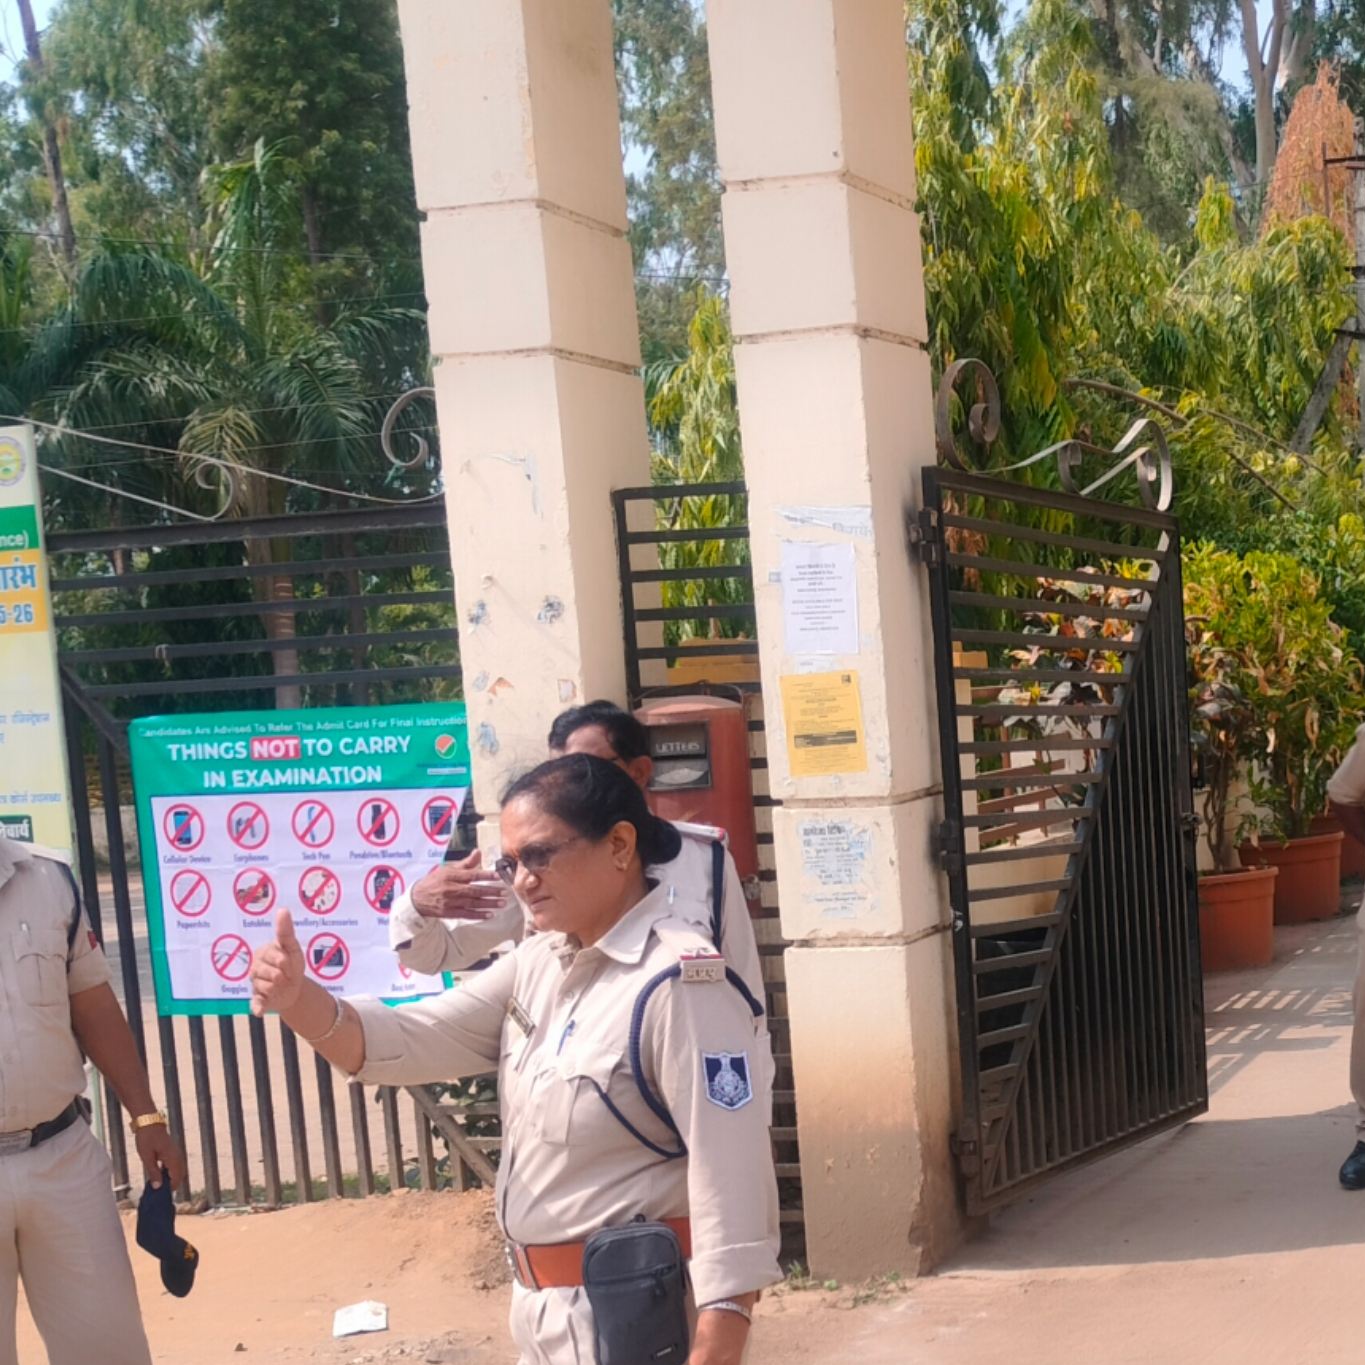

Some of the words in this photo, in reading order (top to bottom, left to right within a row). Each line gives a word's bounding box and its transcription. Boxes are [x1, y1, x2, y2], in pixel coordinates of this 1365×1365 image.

[138, 726, 193, 738] Candidates
[214, 724, 250, 735] Advised
[254, 723, 266, 733] To
[268, 722, 293, 732] Refer
[296, 721, 314, 731] The
[316, 720, 345, 730] Admit
[347, 718, 370, 730] Card
[372, 717, 388, 729] For
[390, 716, 414, 728] Final
[166, 740, 248, 761] THINGS
[252, 738, 299, 759] NOT
[303, 737, 333, 757] TO
[339, 735, 411, 756] CARRY
[656, 742, 700, 754] LETTERS
[203, 770, 226, 788] IN
[232, 765, 382, 788] EXAMINATION
